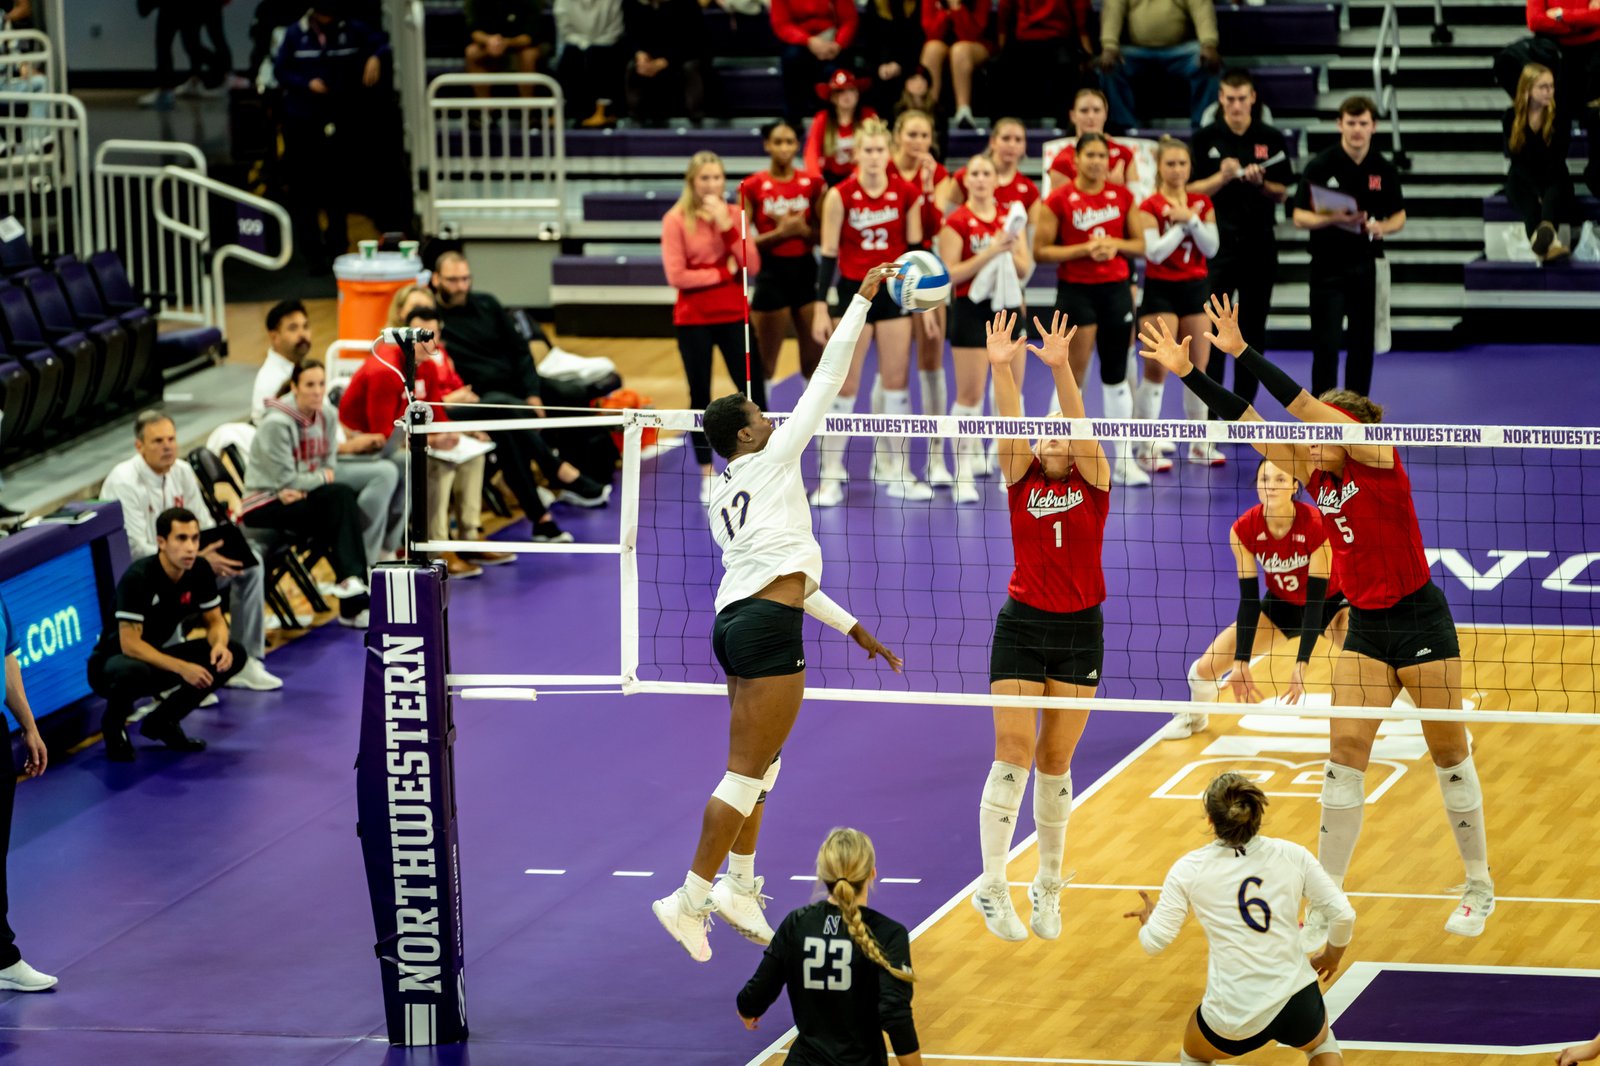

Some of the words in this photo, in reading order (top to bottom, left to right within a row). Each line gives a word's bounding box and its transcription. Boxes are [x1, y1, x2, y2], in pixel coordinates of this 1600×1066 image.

[238, 219, 263, 235] 109
[861, 229, 889, 250] 22
[1182, 242, 1192, 263] 7
[826, 417, 938, 434] NORTHWESTERN
[958, 420, 1072, 436] NORTHWESTERN
[1092, 422, 1207, 438] NORTHWESTERN
[1228, 424, 1343, 440] NORTHWESTERN
[1365, 427, 1481, 443] NORTHWESTERN
[1053, 521, 1062, 548] 1
[1335, 516, 1355, 543] 5
[1274, 574, 1299, 592] 13
[382, 633, 442, 994] NORTHWESTERN
[1238, 876, 1271, 933] 6
[823, 914, 841, 935] N
[803, 936, 853, 991] 23
